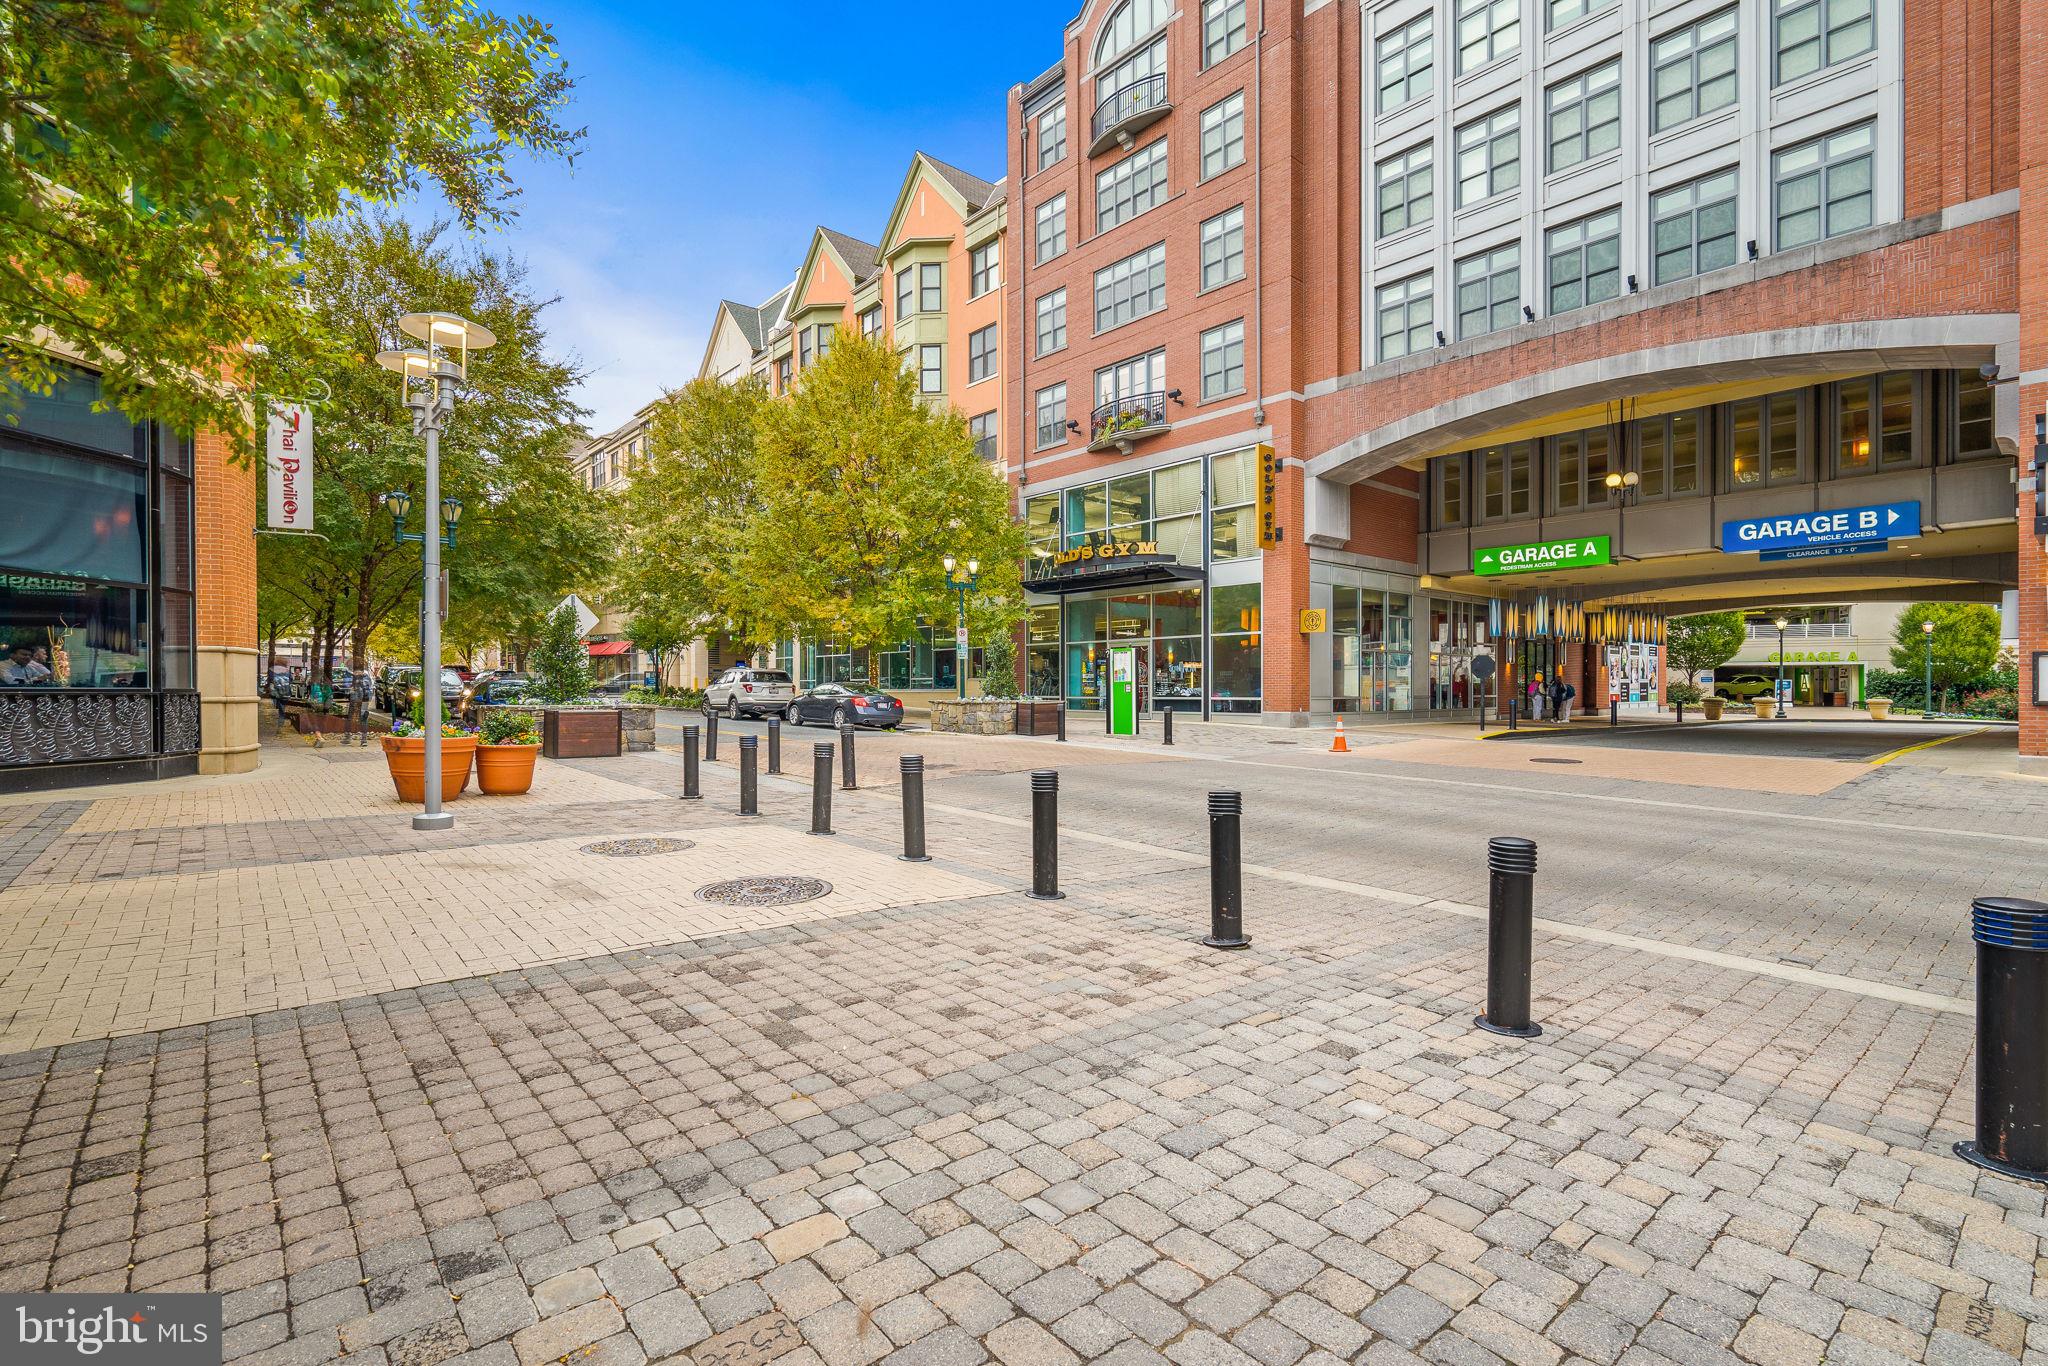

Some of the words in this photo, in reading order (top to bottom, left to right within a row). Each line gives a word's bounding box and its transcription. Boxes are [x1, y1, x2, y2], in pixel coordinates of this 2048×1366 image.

[283, 411, 299, 451] Thai
[278, 457, 300, 524] Pavilion
[1739, 513, 1849, 541] GARAGE
[1859, 510, 1878, 529] B
[1808, 533, 1841, 543] VEHICLE
[1843, 530, 1878, 539] ACCESS
[1099, 541, 1158, 558] GYM
[1499, 543, 1577, 564] GARAGE
[1583, 541, 1597, 556] A
[1787, 549, 1831, 558] CLEARANCE
[1500, 563, 1533, 571] PEDESTRIAN
[1768, 652, 1841, 662] GARAGE
[1848, 651, 1858, 661] A
